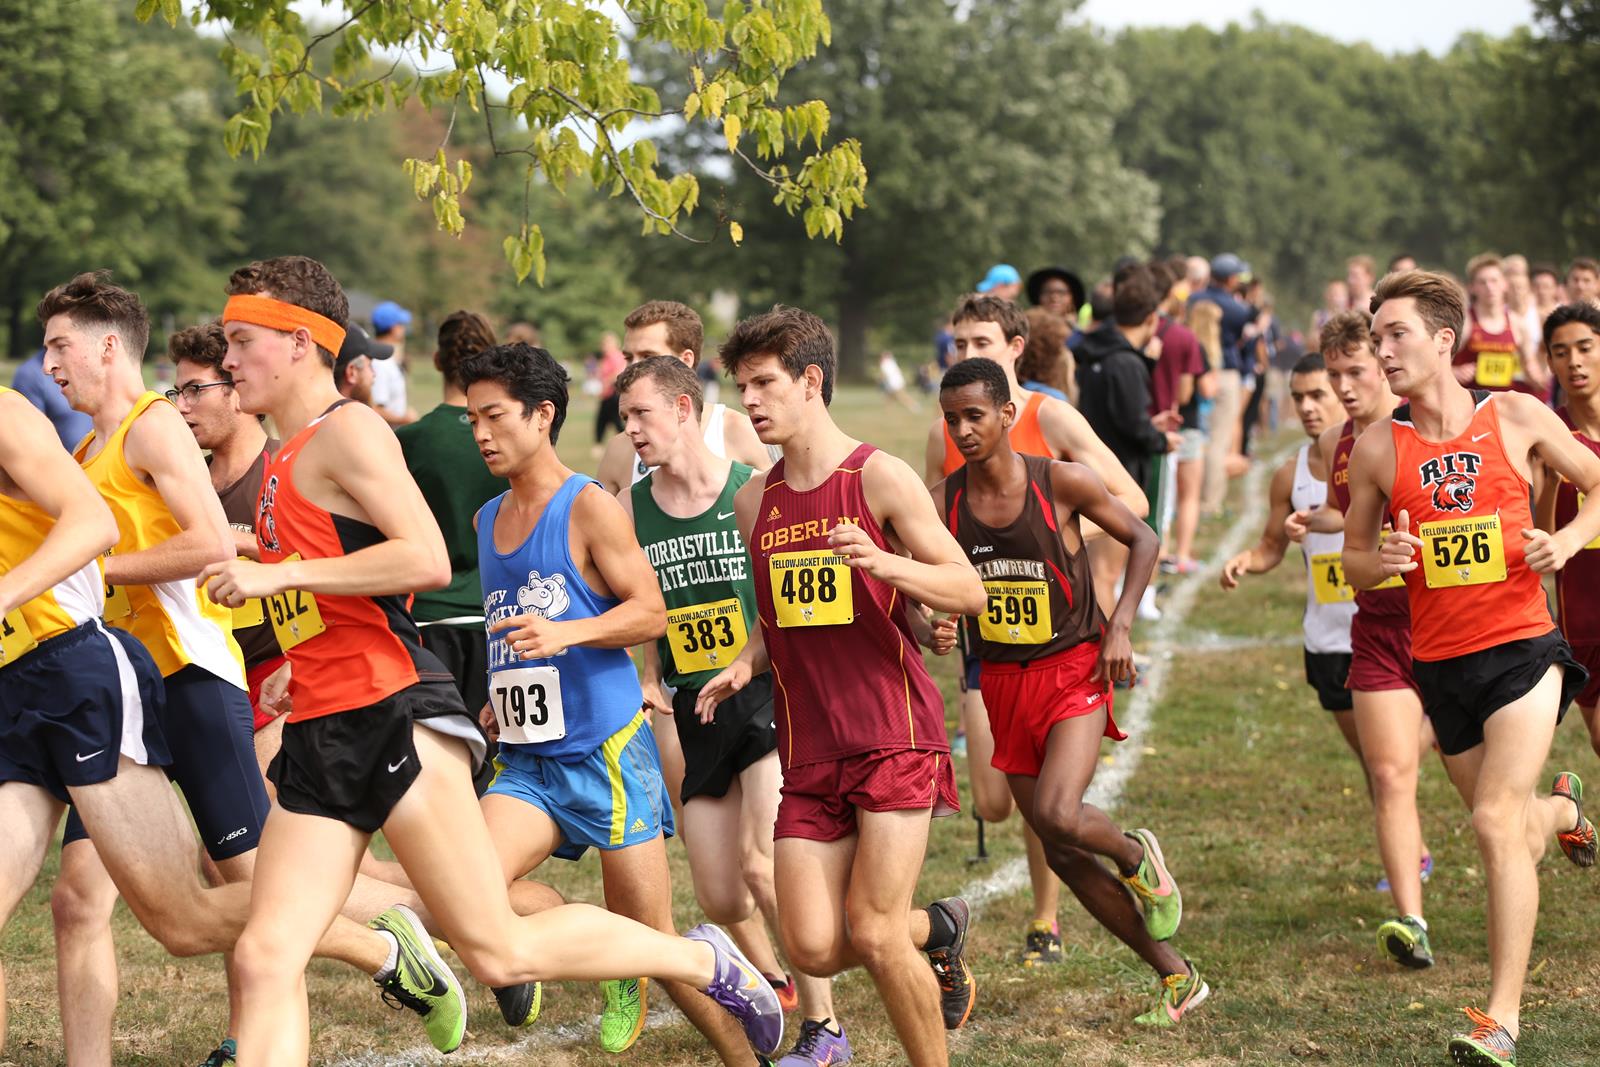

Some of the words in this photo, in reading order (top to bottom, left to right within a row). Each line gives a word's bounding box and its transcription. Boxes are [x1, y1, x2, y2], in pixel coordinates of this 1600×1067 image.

[1419, 451, 1482, 489] RIT
[1422, 523, 1473, 537] YELLOWJACKET
[1475, 521, 1497, 531] INVITE
[772, 557, 820, 570] YELLOWJACKET
[1432, 532, 1491, 568] 526
[655, 562, 689, 592] ATE
[687, 556, 748, 585] COLLEGE
[781, 567, 837, 605] 488
[984, 586, 1024, 596] LLOWJACKET
[1025, 587, 1046, 596] INVITE
[717, 603, 739, 615] INVITE
[987, 595, 1038, 626] 599
[678, 616, 735, 653] 383
[496, 683, 549, 727] 793
